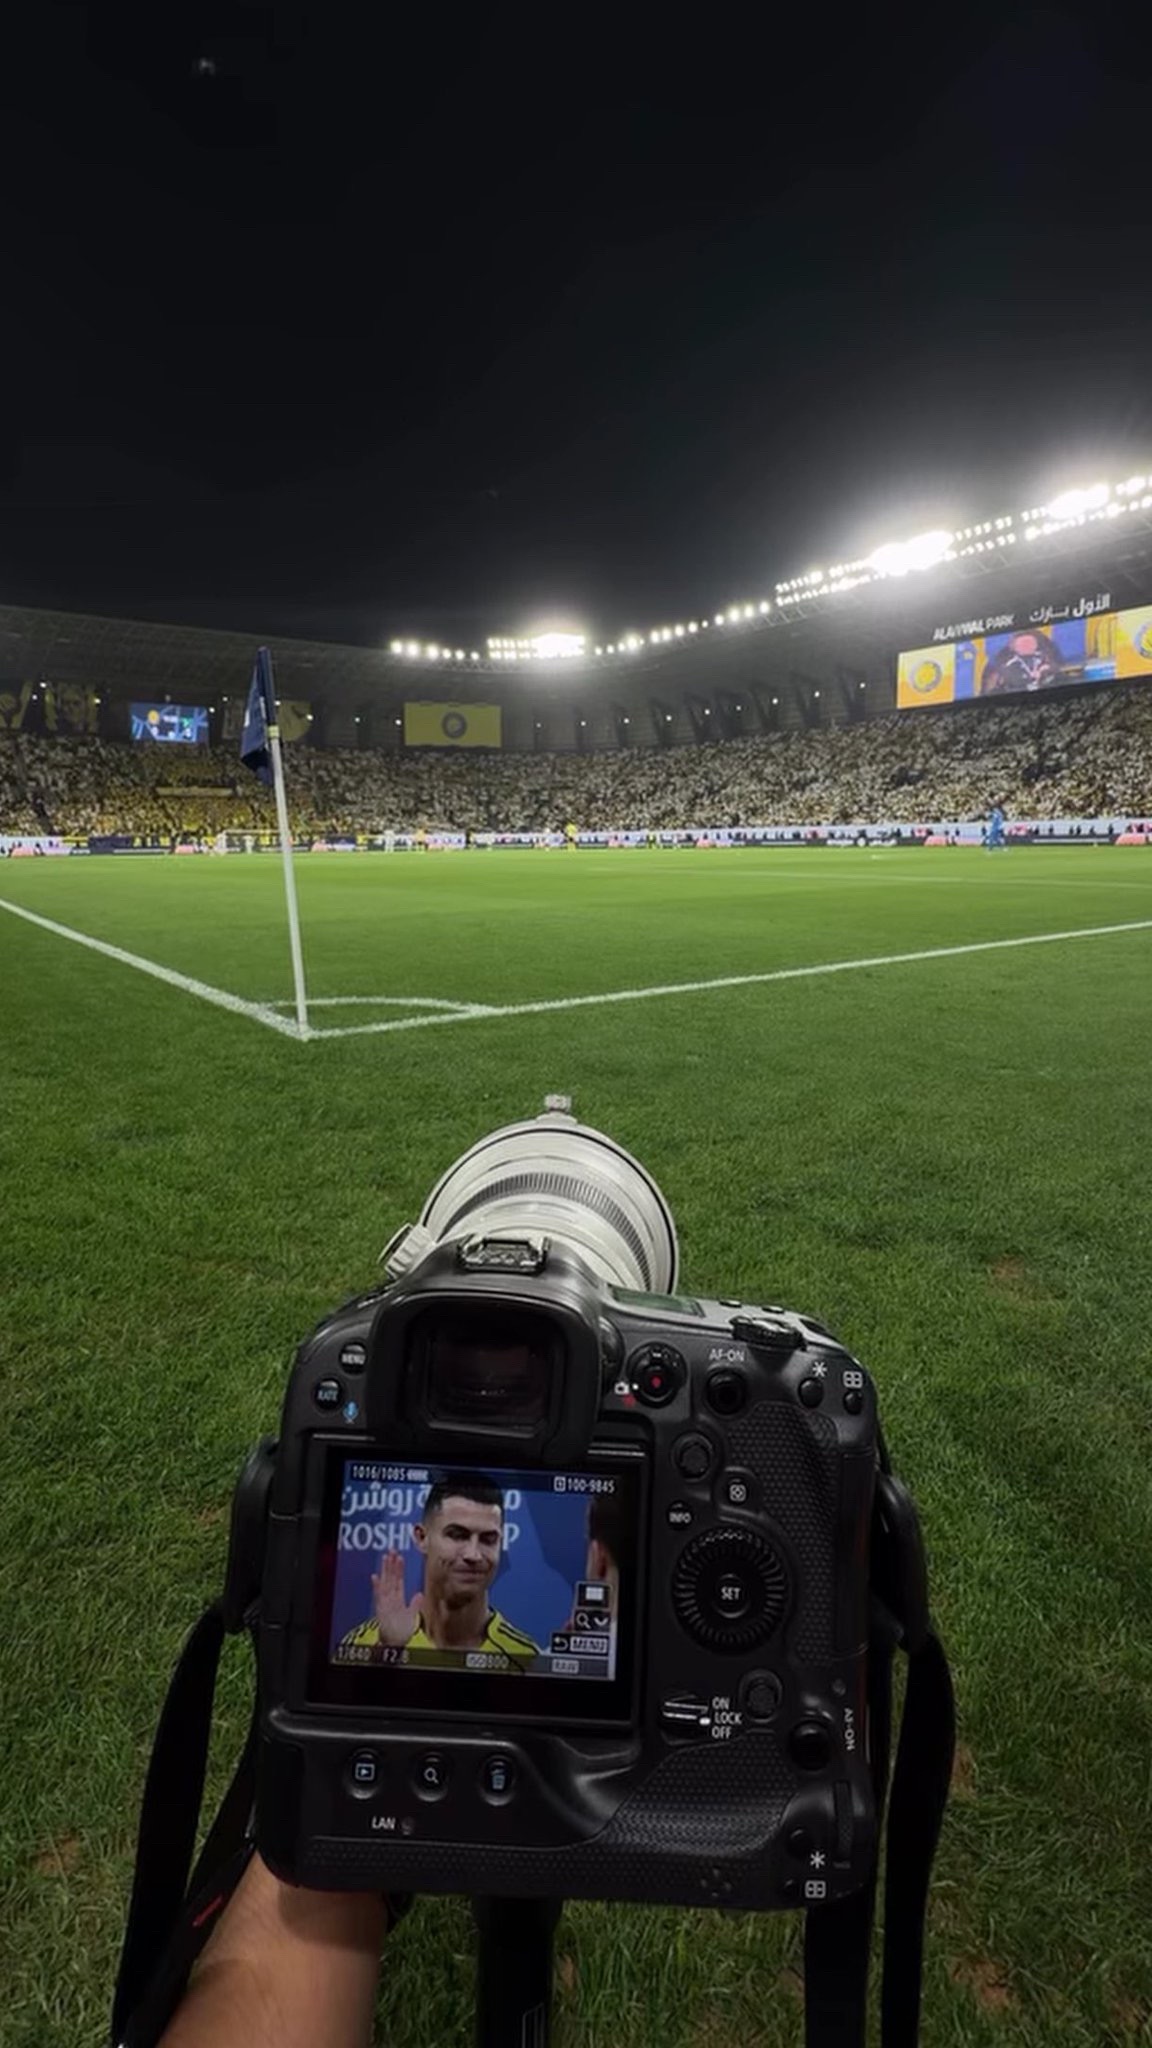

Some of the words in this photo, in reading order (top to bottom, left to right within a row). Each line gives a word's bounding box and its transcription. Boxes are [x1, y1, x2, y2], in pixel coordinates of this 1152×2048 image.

[985, 613, 1015, 629] PARK
[709, 1348, 745, 1362] AF-ON
[669, 1511, 692, 1523] INFO
[721, 1586, 741, 1600] SET
[712, 1696, 730, 1710] ON
[714, 1711, 742, 1725] LOCK
[712, 1725, 732, 1739] OFF
[372, 1816, 396, 1830] LAN
